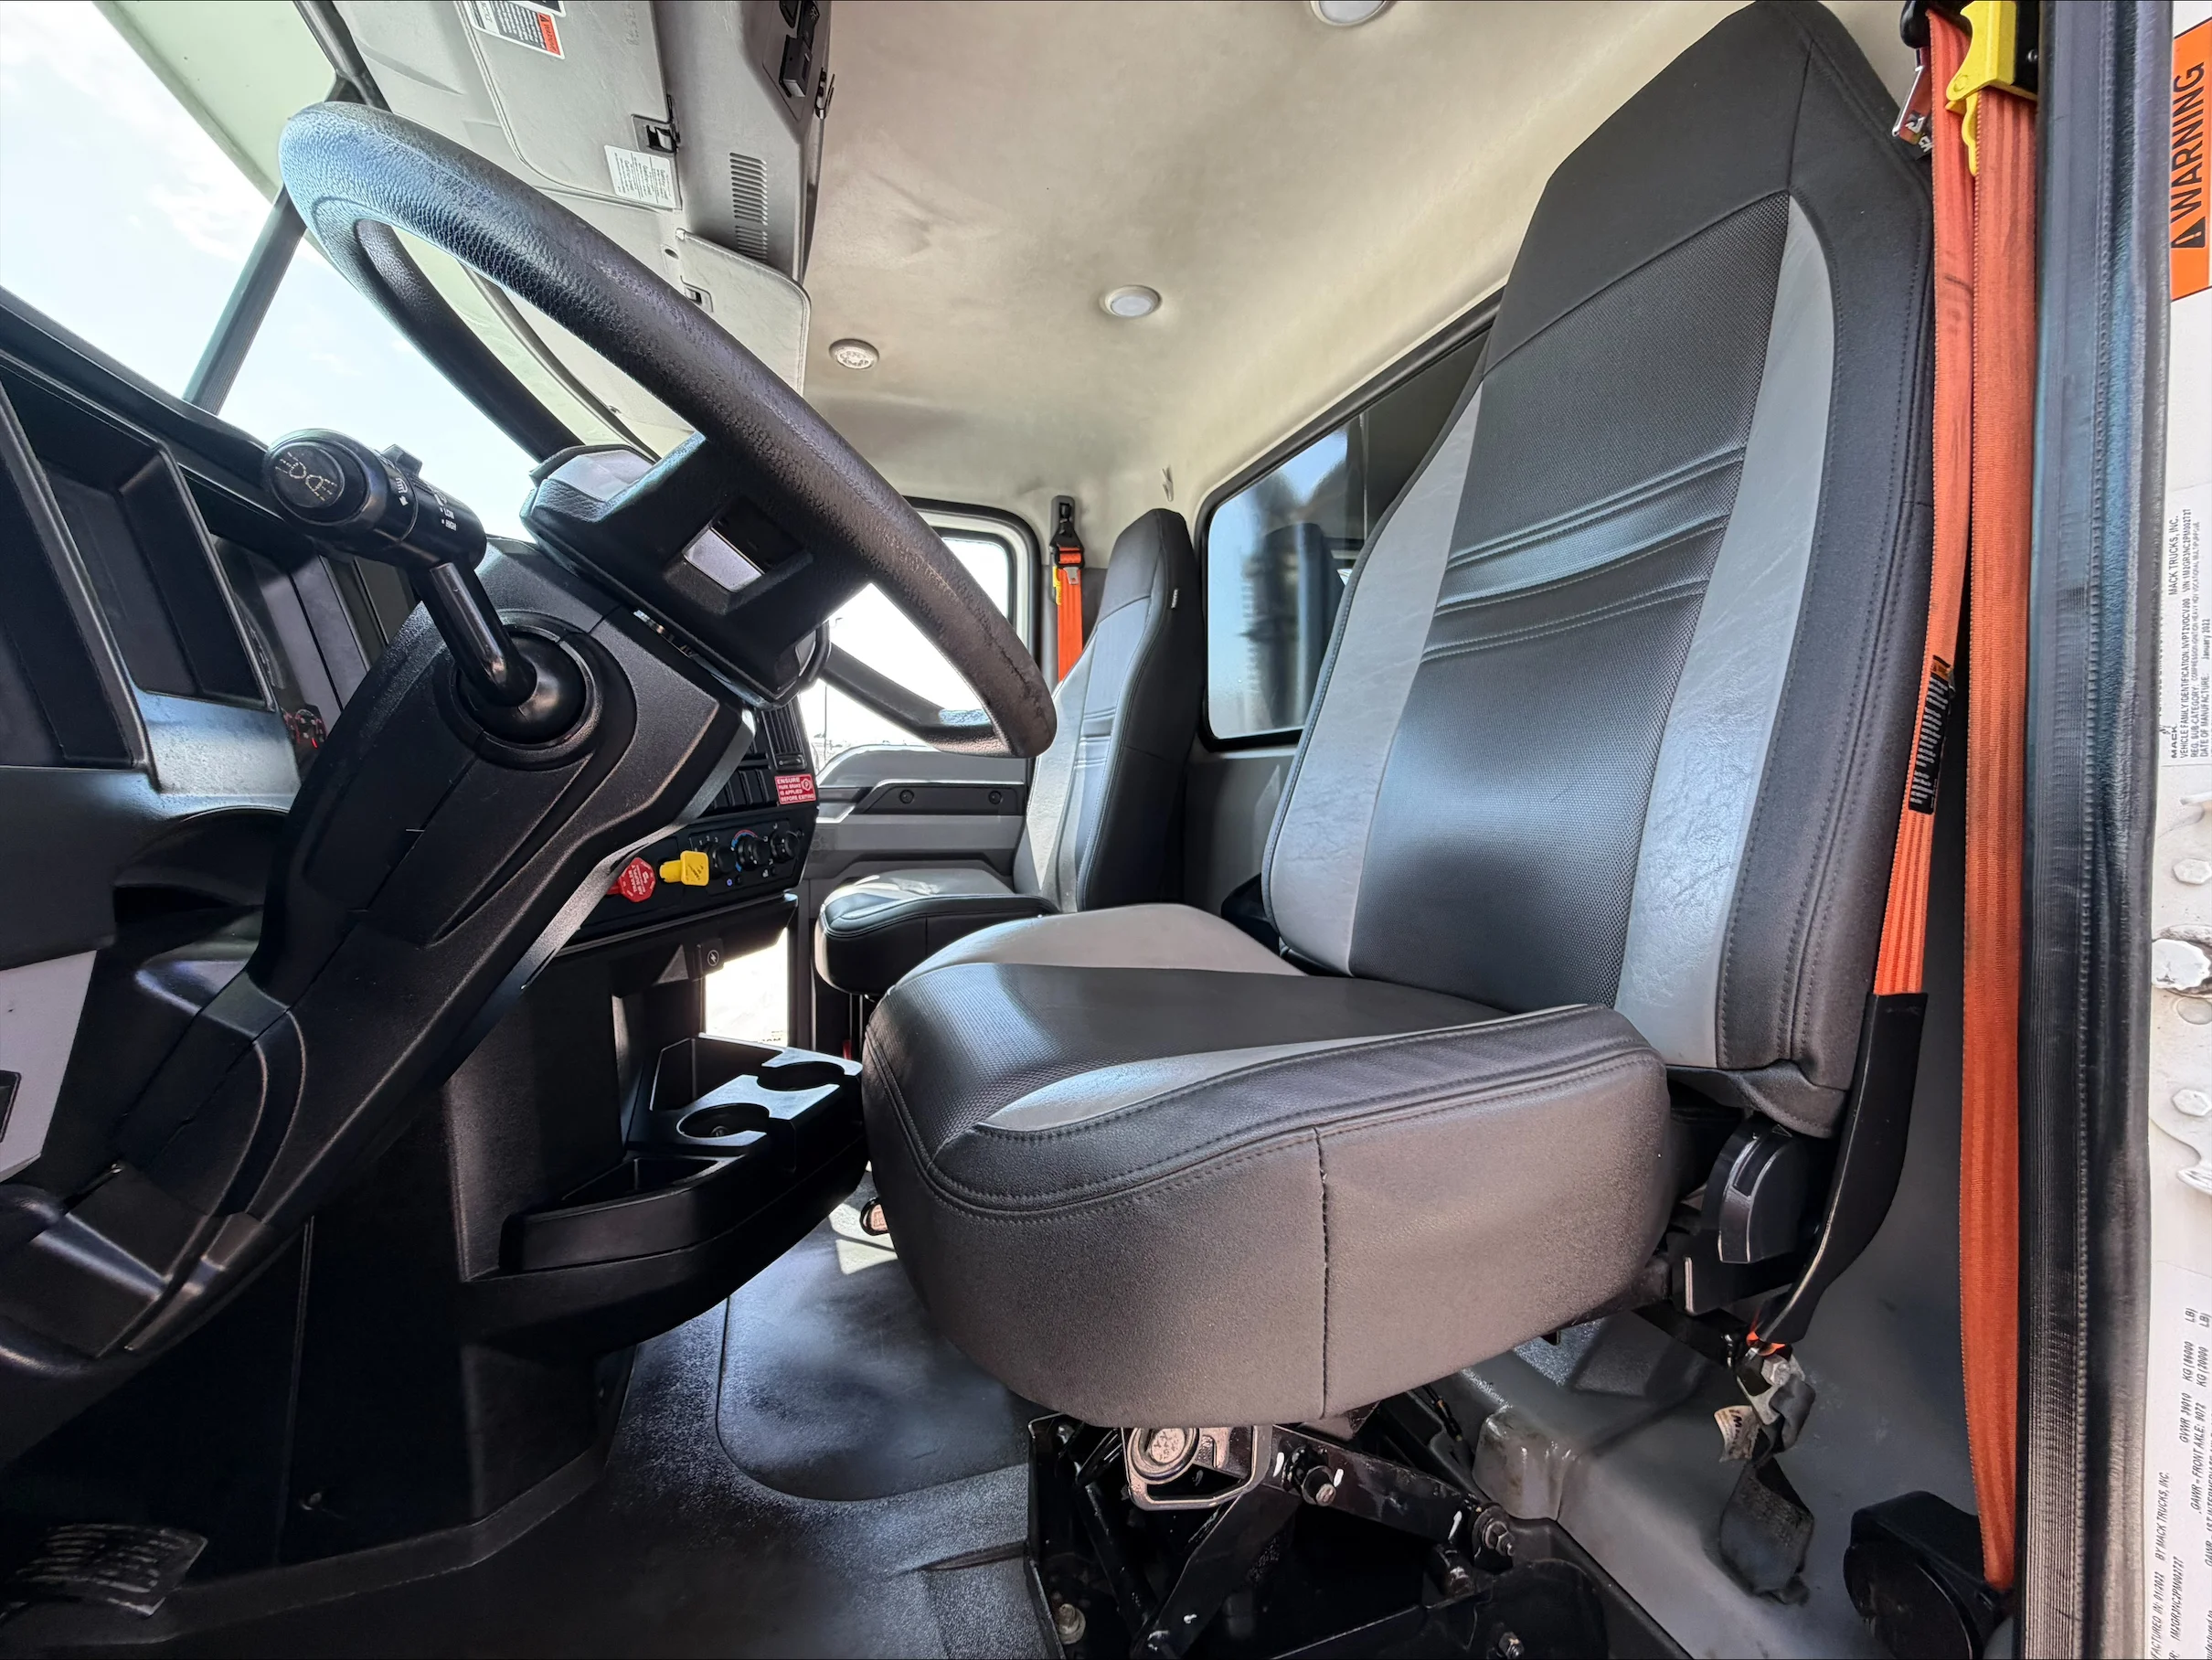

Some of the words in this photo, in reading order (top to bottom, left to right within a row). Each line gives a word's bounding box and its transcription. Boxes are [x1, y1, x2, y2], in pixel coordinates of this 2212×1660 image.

[2170, 62, 2205, 223] WARNING
[2169, 516, 2179, 533] INC.
[2169, 534, 2181, 570] TRUCKS,
[2169, 572, 2178, 595] MACK
[2202, 619, 2210, 633] 2022
[2202, 635, 2212, 660] January
[2191, 685, 2200, 739] SUB-CATEGORY:
[2200, 674, 2210, 727] MANUFACTURE:
[2180, 703, 2189, 728] FAMILY
[2170, 726, 2178, 759] MACK
[2180, 729, 2189, 759] VEHICLE
[2200, 729, 2209, 738] OF
[2190, 741, 2199, 757] REG.
[2200, 739, 2209, 758] DATE
[628, 869, 638, 893] TRAILER
[2185, 1307, 2197, 1323] LB)
[2198, 1312, 2212, 1328] LB)
[2183, 1341, 2196, 1368] (86000
[2196, 1346, 2209, 1374] (20000
[2182, 1369, 2194, 1382] KG
[2196, 1374, 2207, 1388] KG
[2181, 1392, 2192, 1416] 39010
[2195, 1402, 2206, 1422] 9072
[2179, 1418, 2191, 1443] GVWR
[2193, 1423, 2205, 1449] AXLE:
[2192, 1448, 2204, 1478] FRONT
[2159, 1472, 2170, 1488] INC.
[2156, 1489, 2169, 1523] TRUCKS,
[2155, 1523, 2166, 1548] MACK
[2154, 1547, 2165, 1561] BY
[2154, 1571, 2165, 1601] 01/2022
[2151, 1615, 2162, 1659] FACTURED
